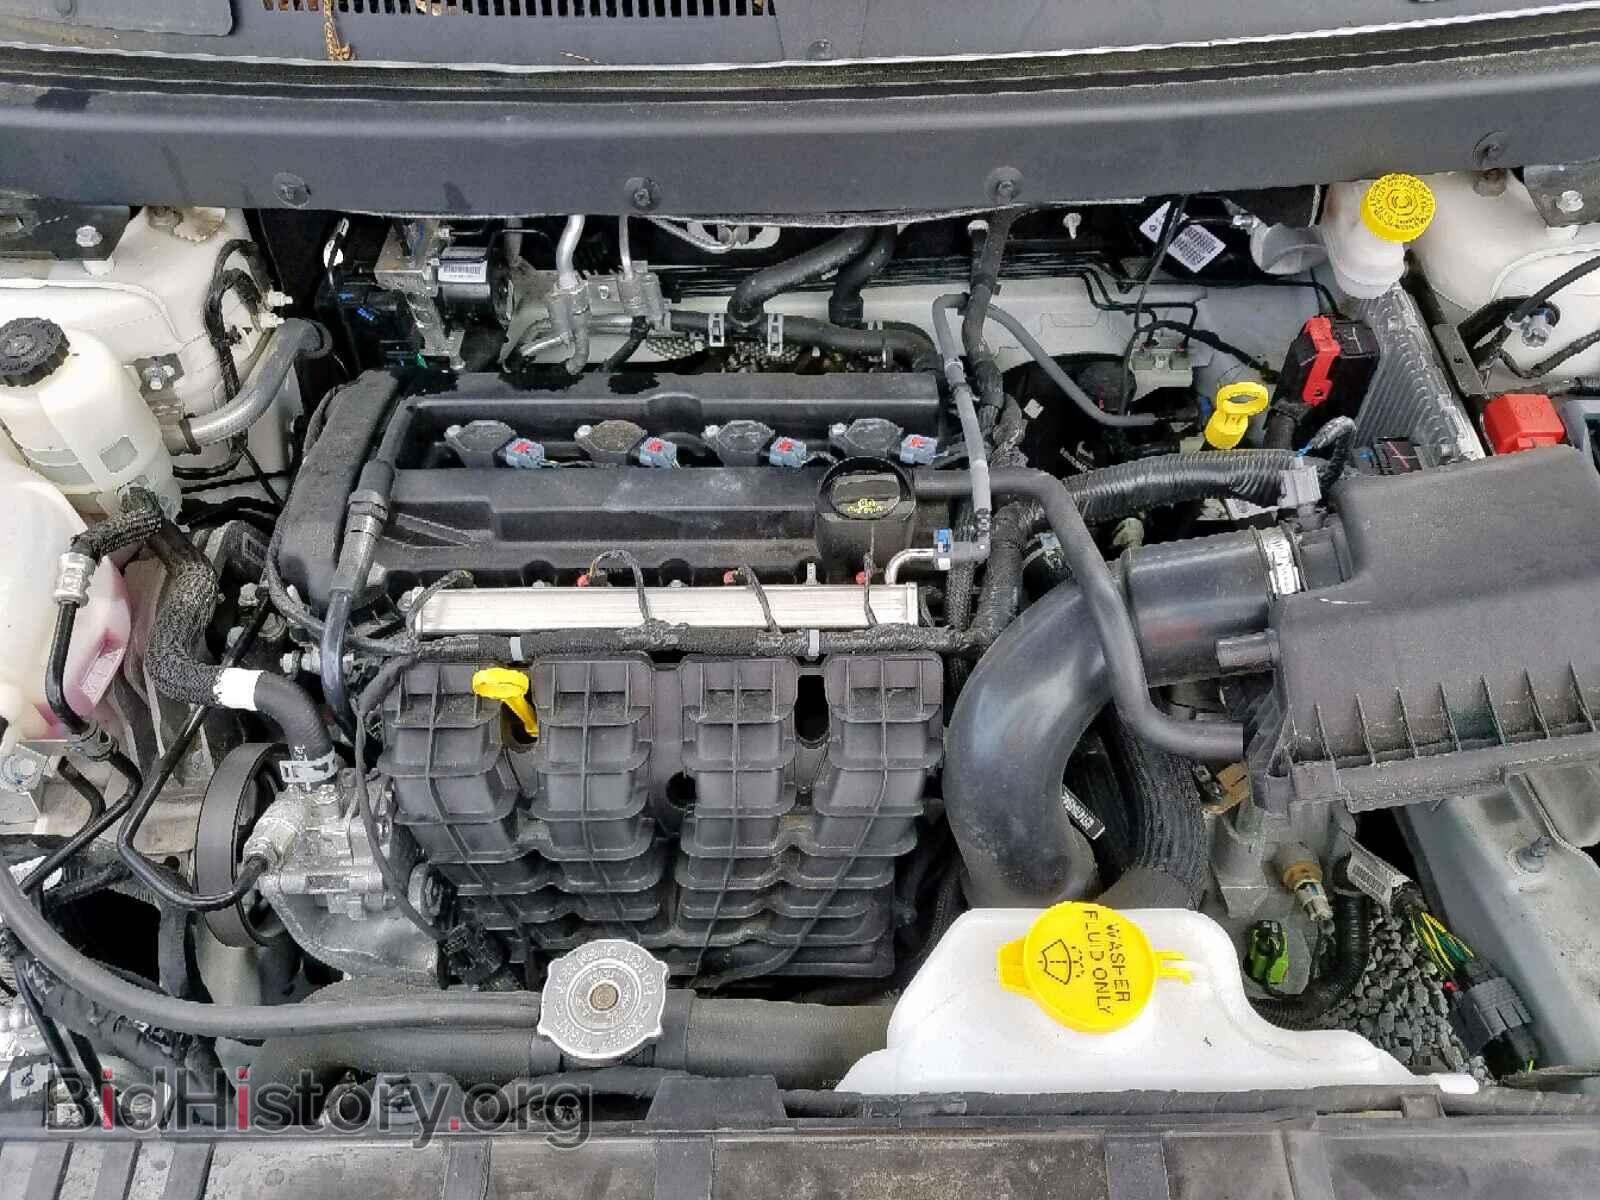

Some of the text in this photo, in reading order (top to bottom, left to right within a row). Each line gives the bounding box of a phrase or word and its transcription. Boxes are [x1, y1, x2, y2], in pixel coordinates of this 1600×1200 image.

[1083, 910, 1115, 1017] FLUID ONLY
[1106, 922, 1131, 1002] WASHER
